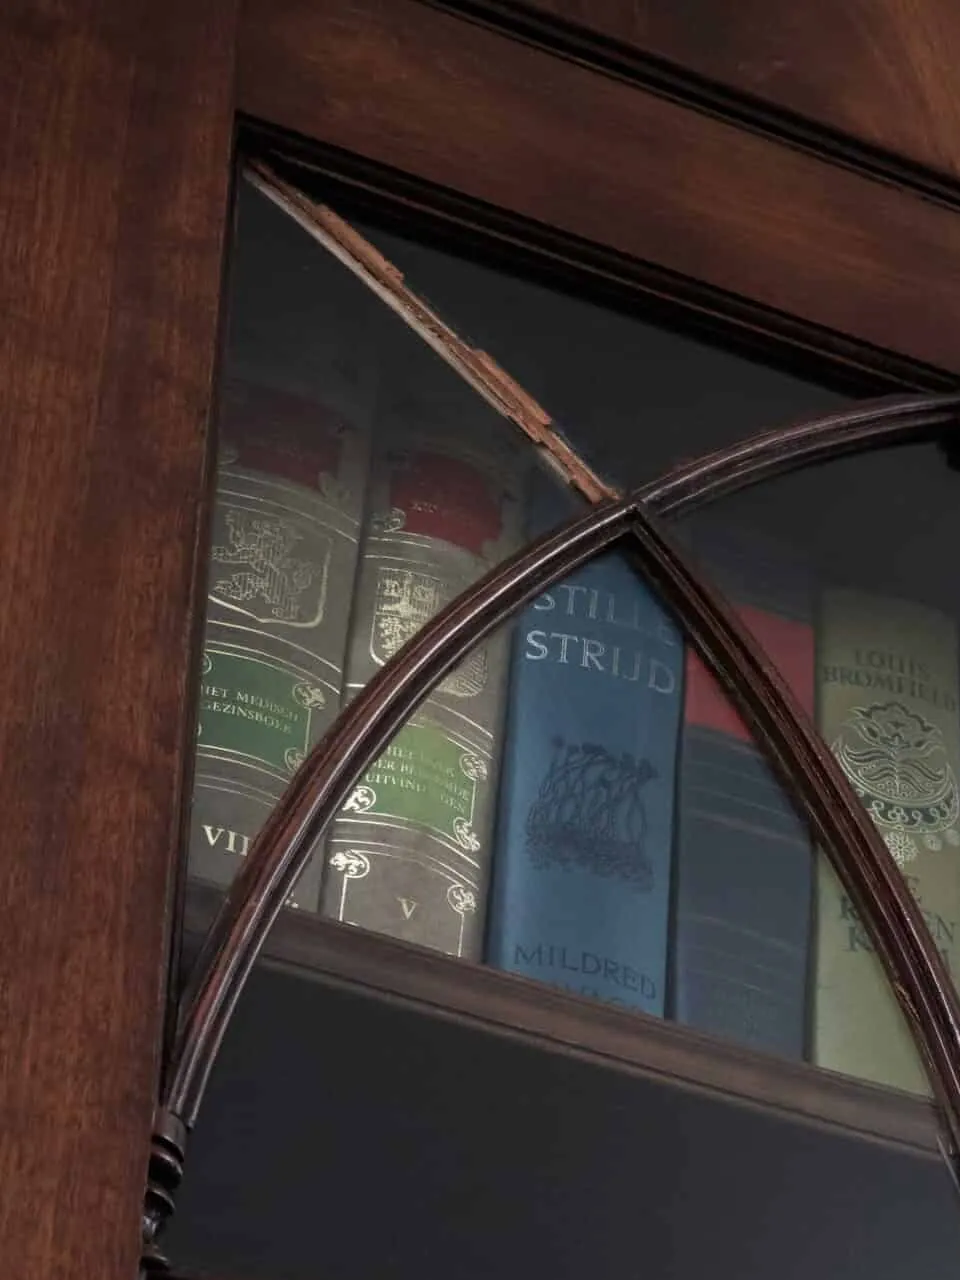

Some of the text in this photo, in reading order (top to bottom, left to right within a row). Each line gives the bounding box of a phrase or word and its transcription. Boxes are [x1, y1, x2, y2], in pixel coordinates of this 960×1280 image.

[525, 630, 675, 694] STRIJD
[398, 898, 418, 921] V
[514, 943, 656, 1000] MILDRED
